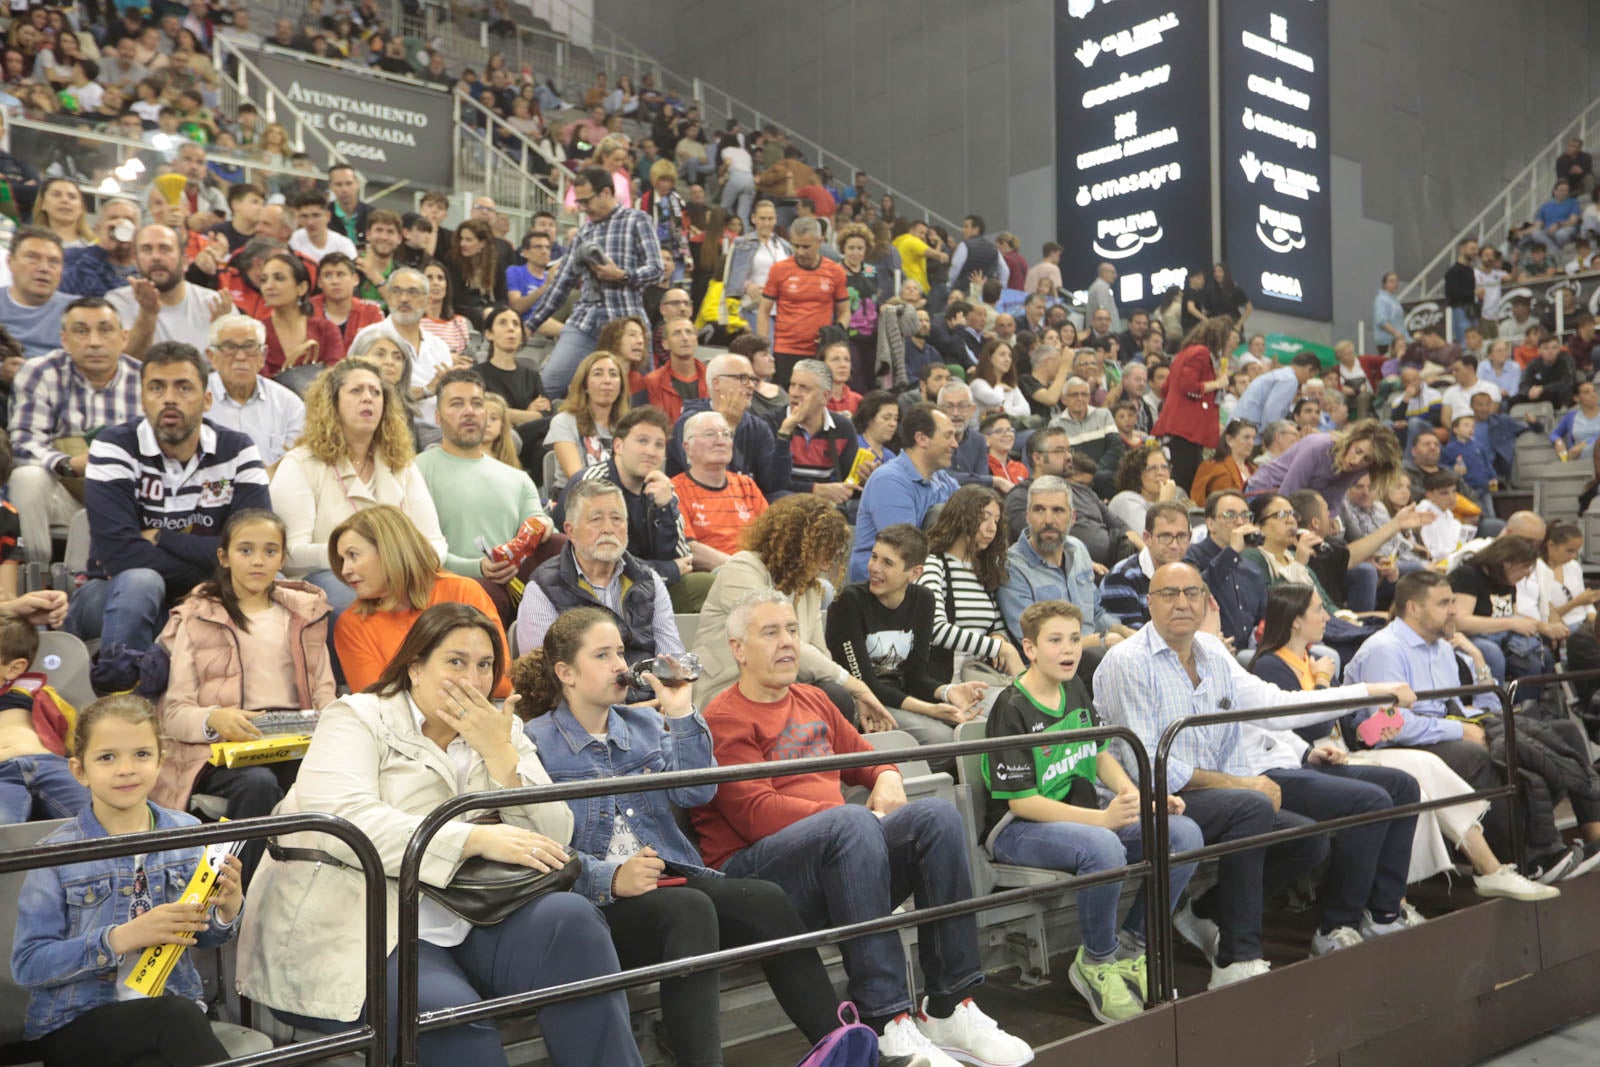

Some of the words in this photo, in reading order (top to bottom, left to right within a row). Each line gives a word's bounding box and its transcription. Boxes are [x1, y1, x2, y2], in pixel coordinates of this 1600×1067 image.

[287, 81, 428, 127] AYUNTAMIENTO
[328, 111, 416, 147] GRANADA
[1091, 162, 1181, 201] emasagra
[141, 477, 164, 500] 10
